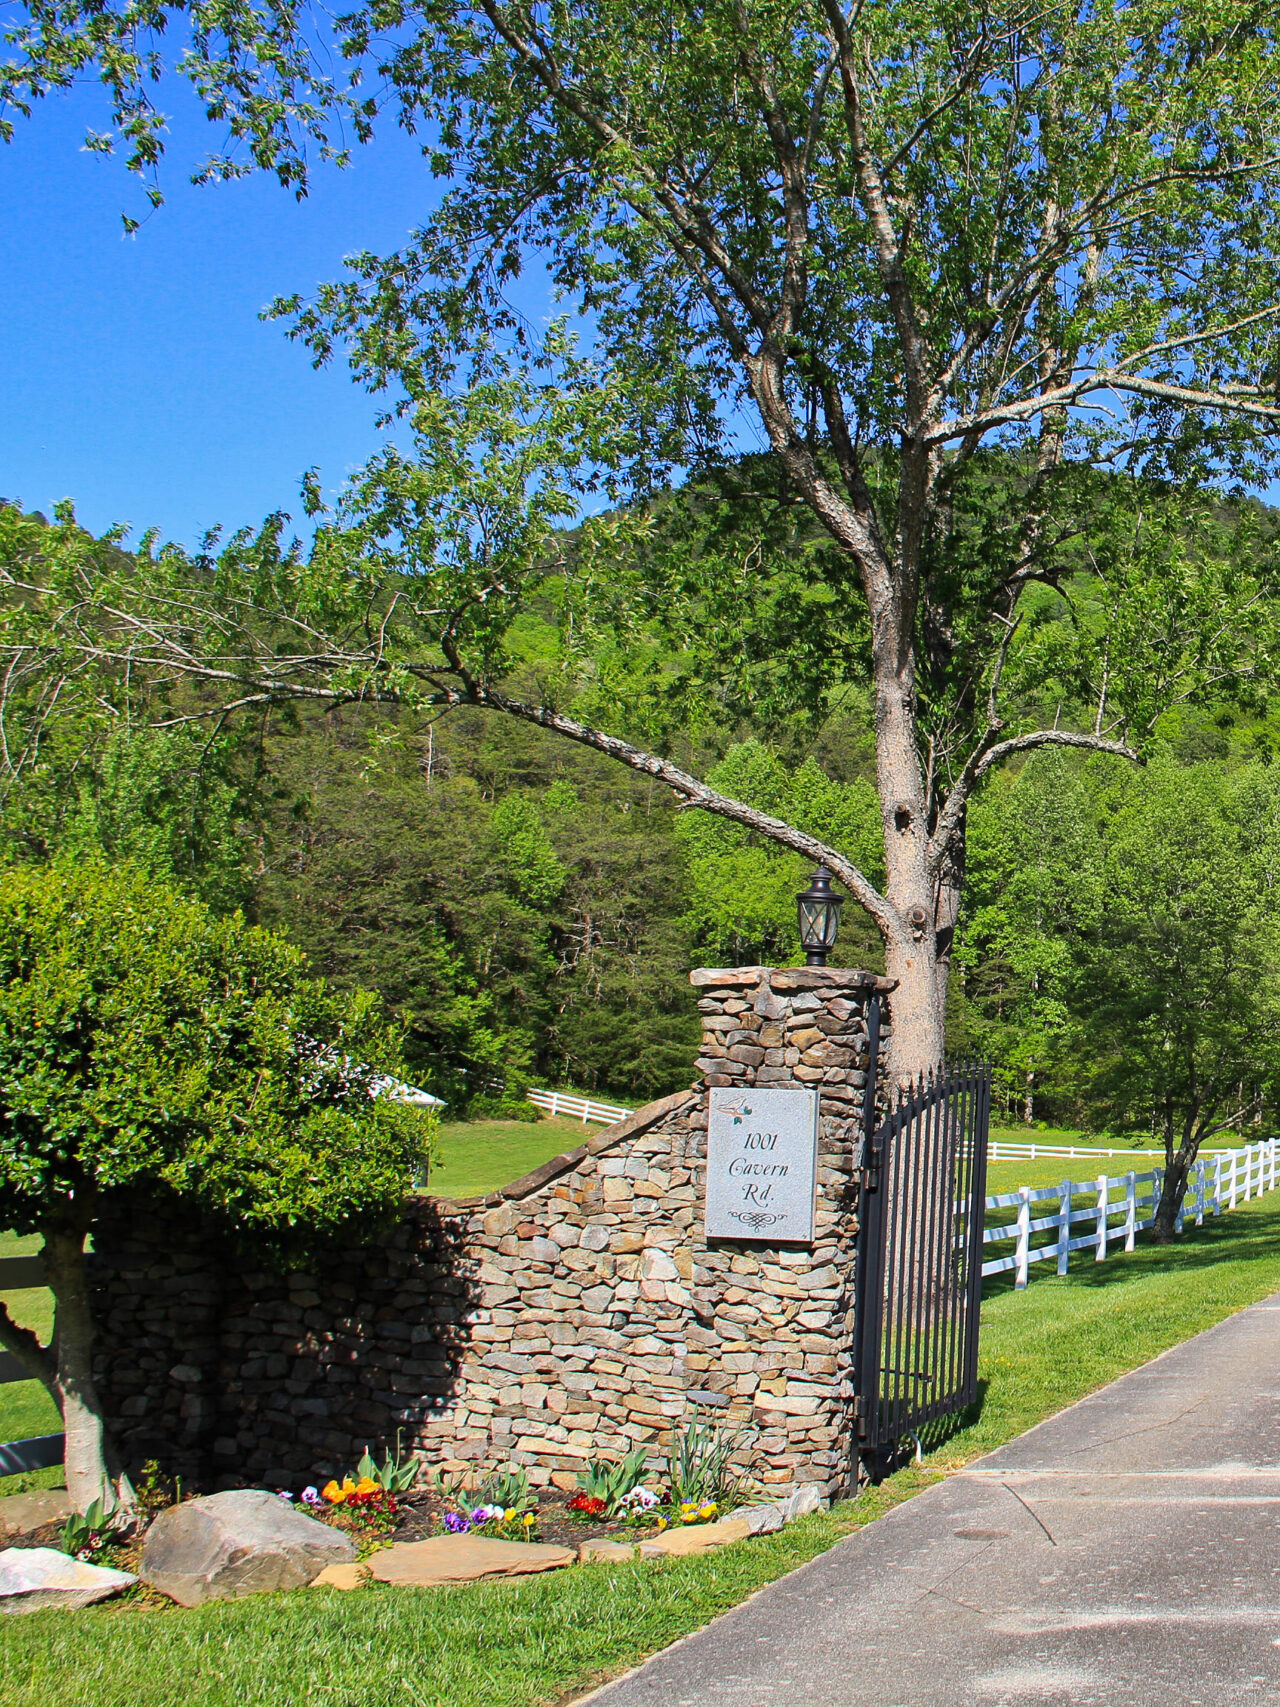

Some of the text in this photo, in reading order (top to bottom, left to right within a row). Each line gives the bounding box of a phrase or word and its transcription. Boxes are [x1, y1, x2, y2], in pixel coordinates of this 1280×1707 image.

[744, 1133, 778, 1150] 1001
[728, 1157, 789, 1177] Cavern
[742, 1183, 775, 1208] Rd.
